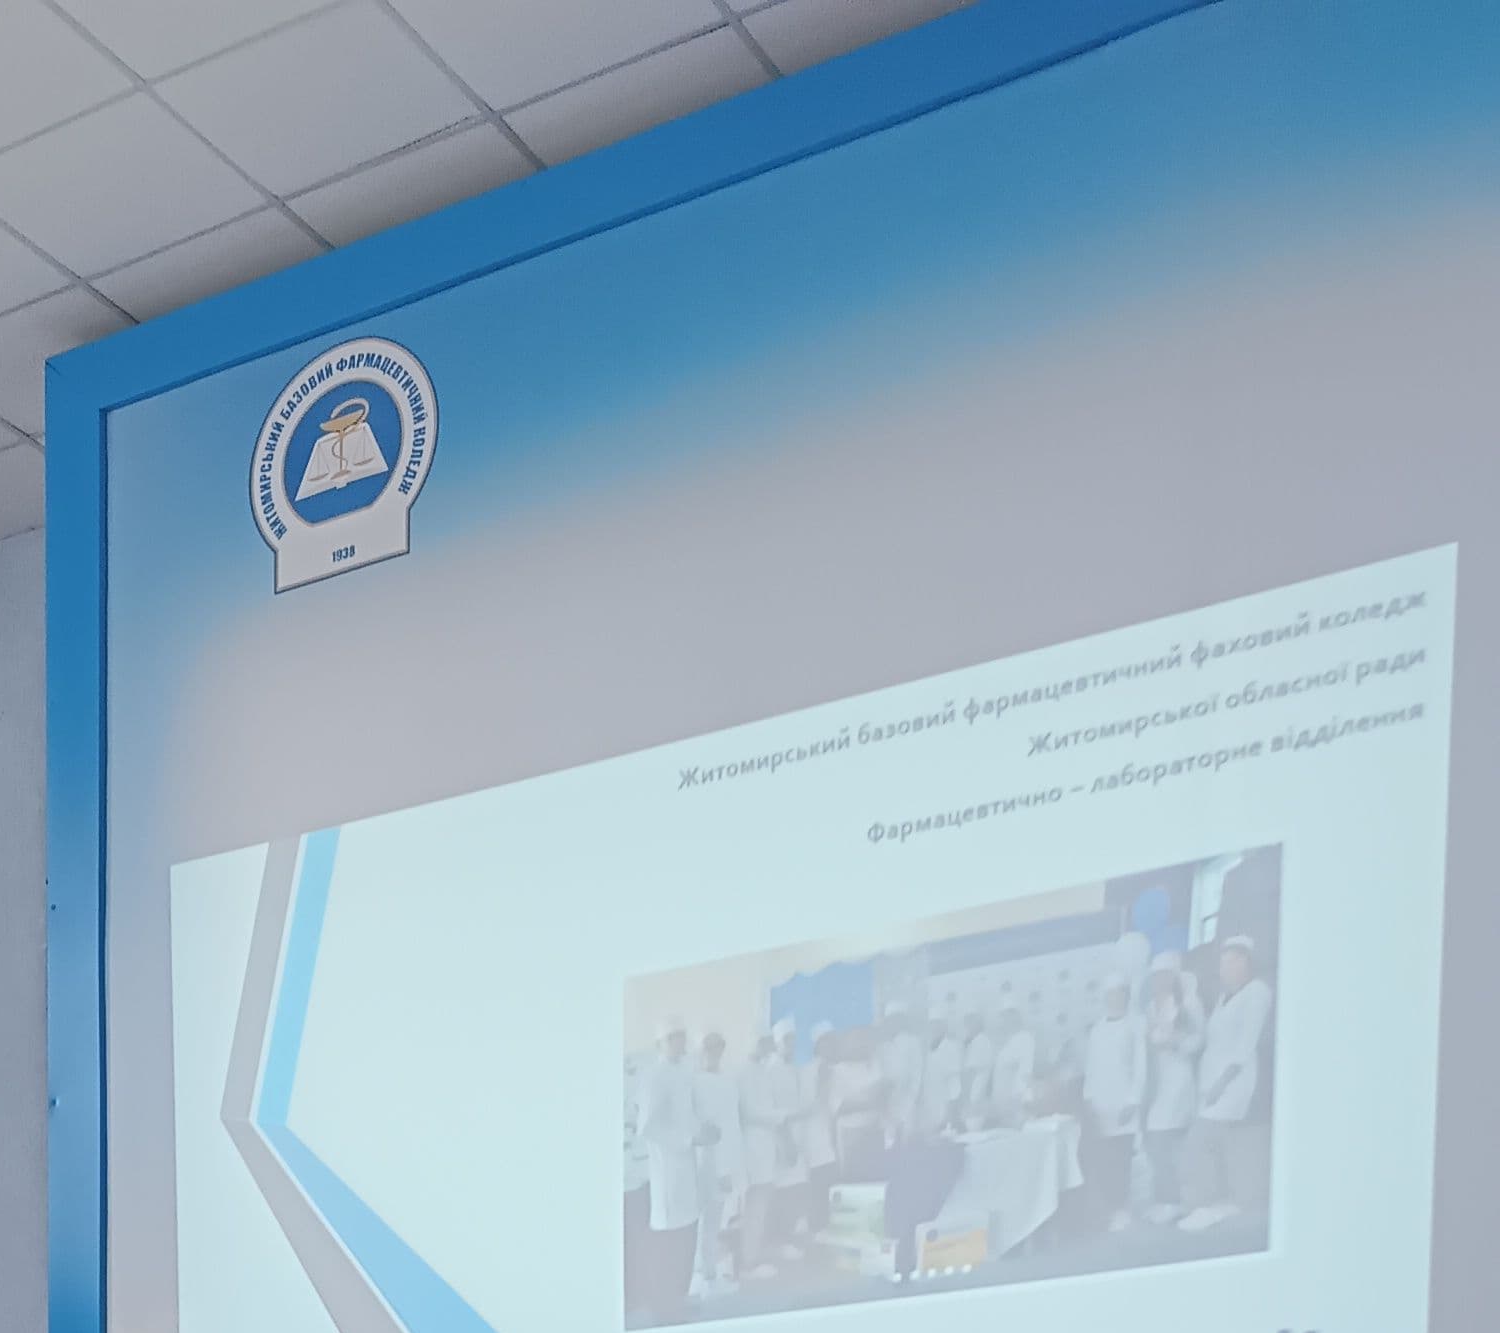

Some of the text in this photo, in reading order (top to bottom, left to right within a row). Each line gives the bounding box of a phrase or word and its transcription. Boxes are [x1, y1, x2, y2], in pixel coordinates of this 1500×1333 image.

[259, 421, 288, 540] ЖИТОМИРСЬКИЙ
[280, 362, 333, 420] БАЗОВИЙ
[678, 590, 1427, 790] Житомирський базовий фармацевтичний фаховий коледж
[1026, 646, 1427, 757] Житомирської обласної ради
[867, 784, 1063, 844] Фармацевтично
[1090, 738, 1262, 795] лабораторне
[1270, 702, 1426, 754] відділення
